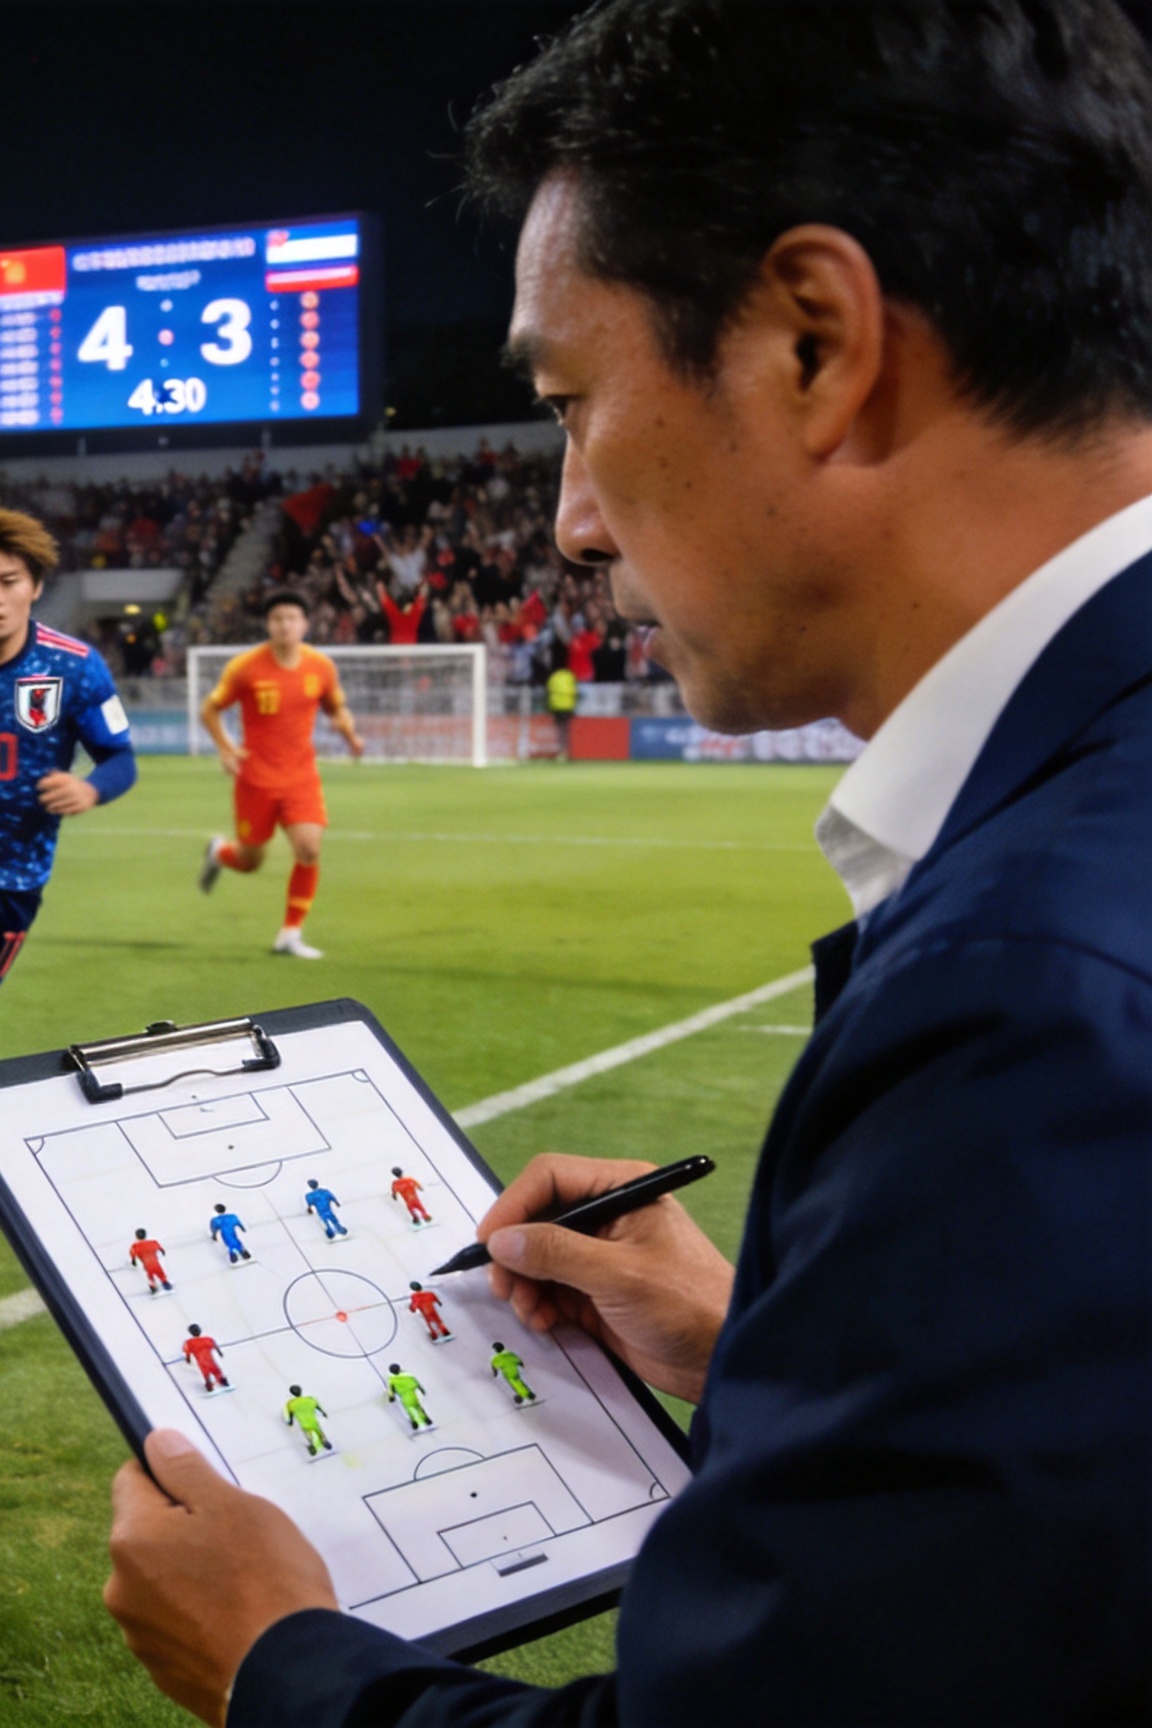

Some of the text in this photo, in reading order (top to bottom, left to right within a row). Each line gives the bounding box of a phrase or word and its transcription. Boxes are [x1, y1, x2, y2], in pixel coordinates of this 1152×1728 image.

[77, 305, 133, 370] 4
[200, 298, 252, 365] 3
[128, 377, 206, 414] 4.30
